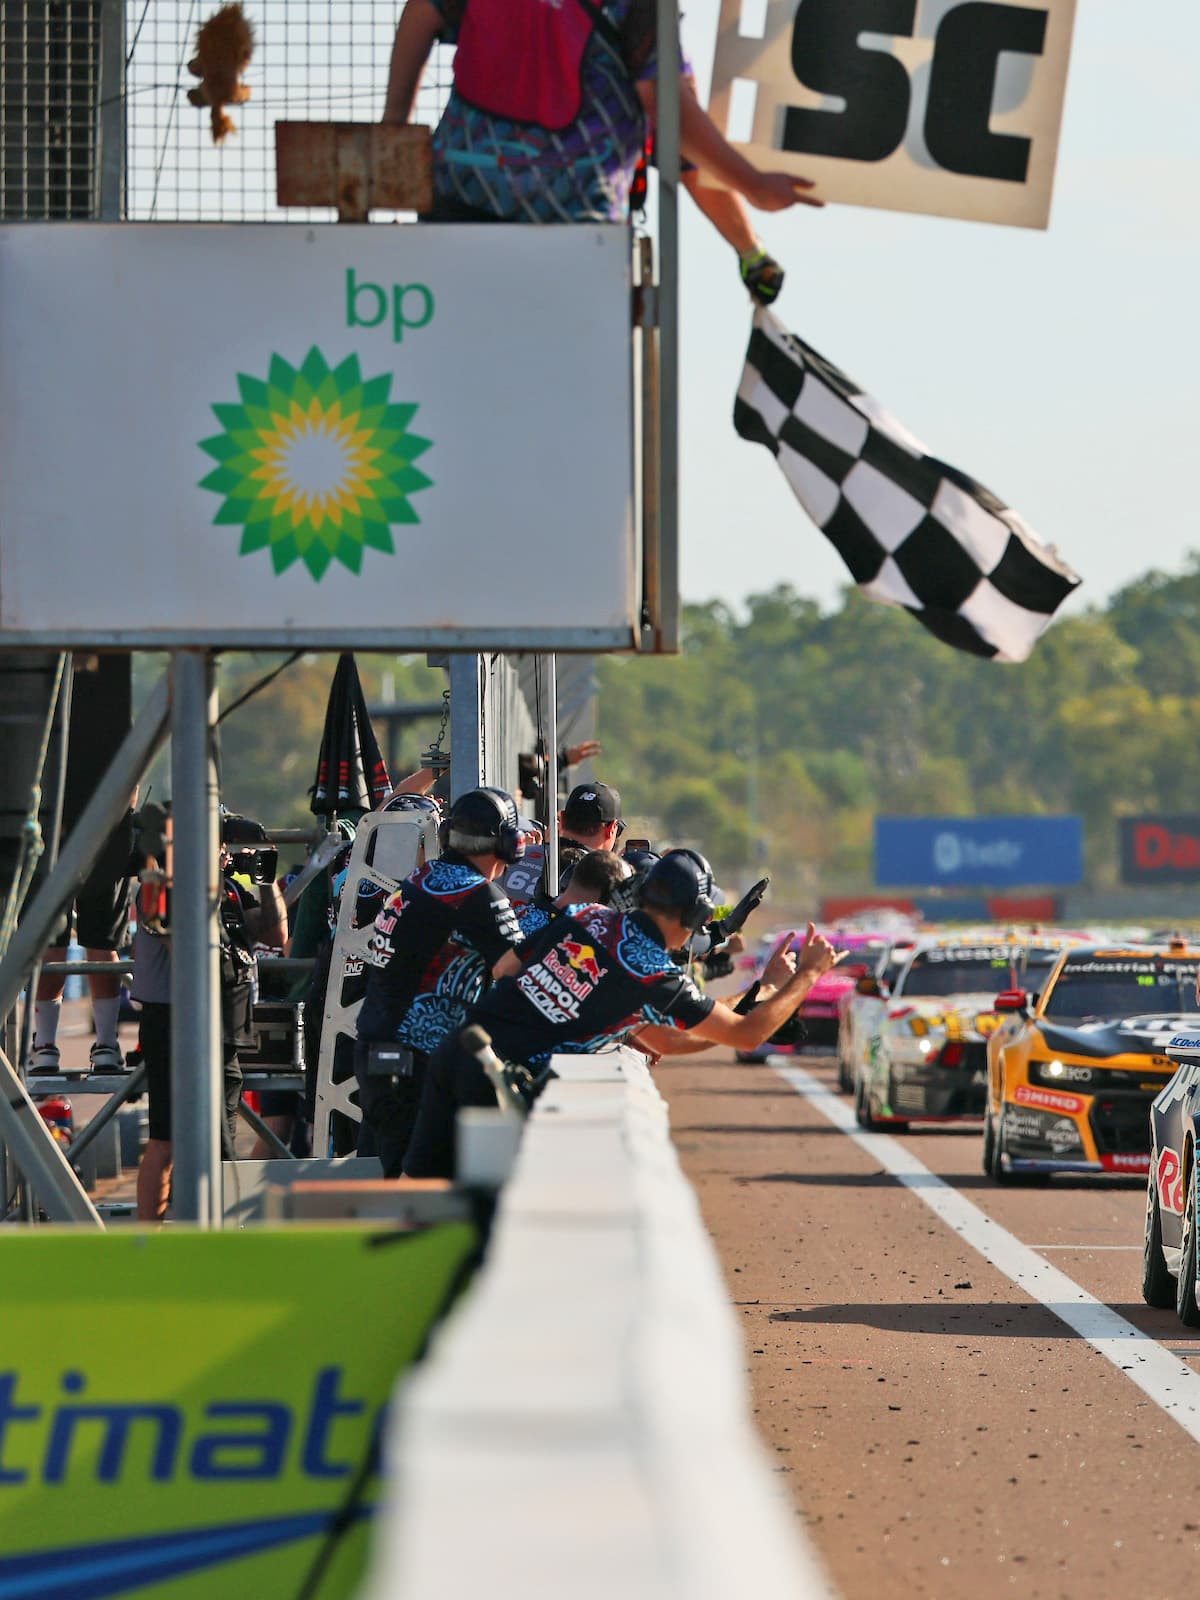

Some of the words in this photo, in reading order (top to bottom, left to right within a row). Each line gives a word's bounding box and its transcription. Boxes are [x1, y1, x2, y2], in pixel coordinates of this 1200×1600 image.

[782, 0, 1048, 183] SC
[346, 267, 435, 343] bp
[517, 974, 572, 1024] RACING
[527, 963, 581, 1018] AMPOL
[543, 949, 566, 978] Red
[561, 969, 594, 1001] Bull
[0, 1366, 392, 1486] timat
